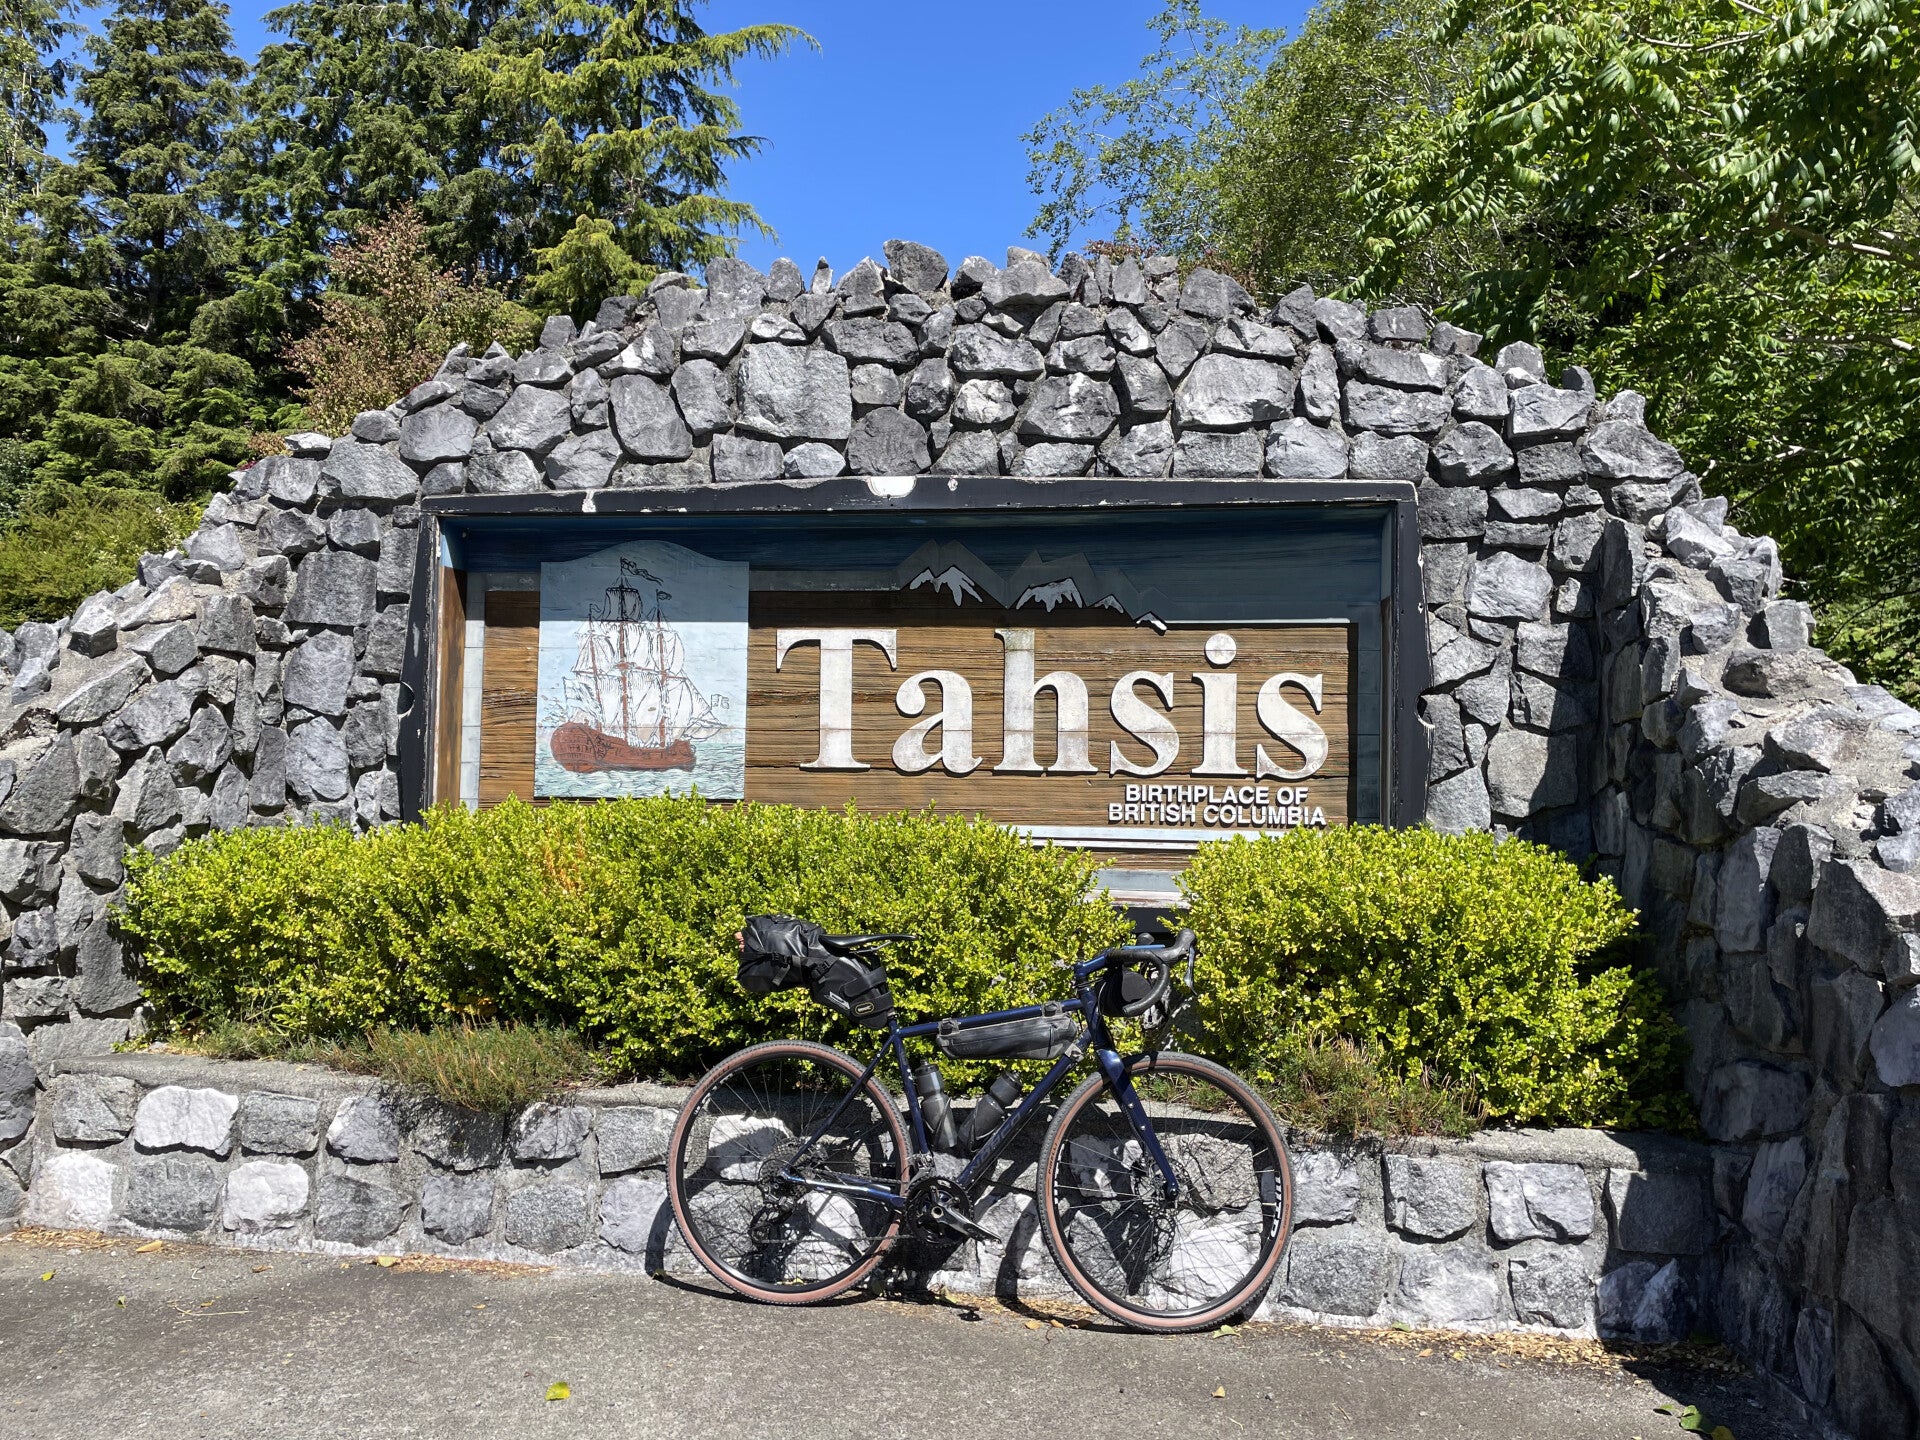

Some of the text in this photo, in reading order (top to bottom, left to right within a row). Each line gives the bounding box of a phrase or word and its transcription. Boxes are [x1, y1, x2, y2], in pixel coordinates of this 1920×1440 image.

[776, 628, 1329, 780] Tahsis
[1125, 784, 1309, 805] BIRTHPLACE OF
[1108, 802, 1327, 826] BRITISH COLUMBIA
